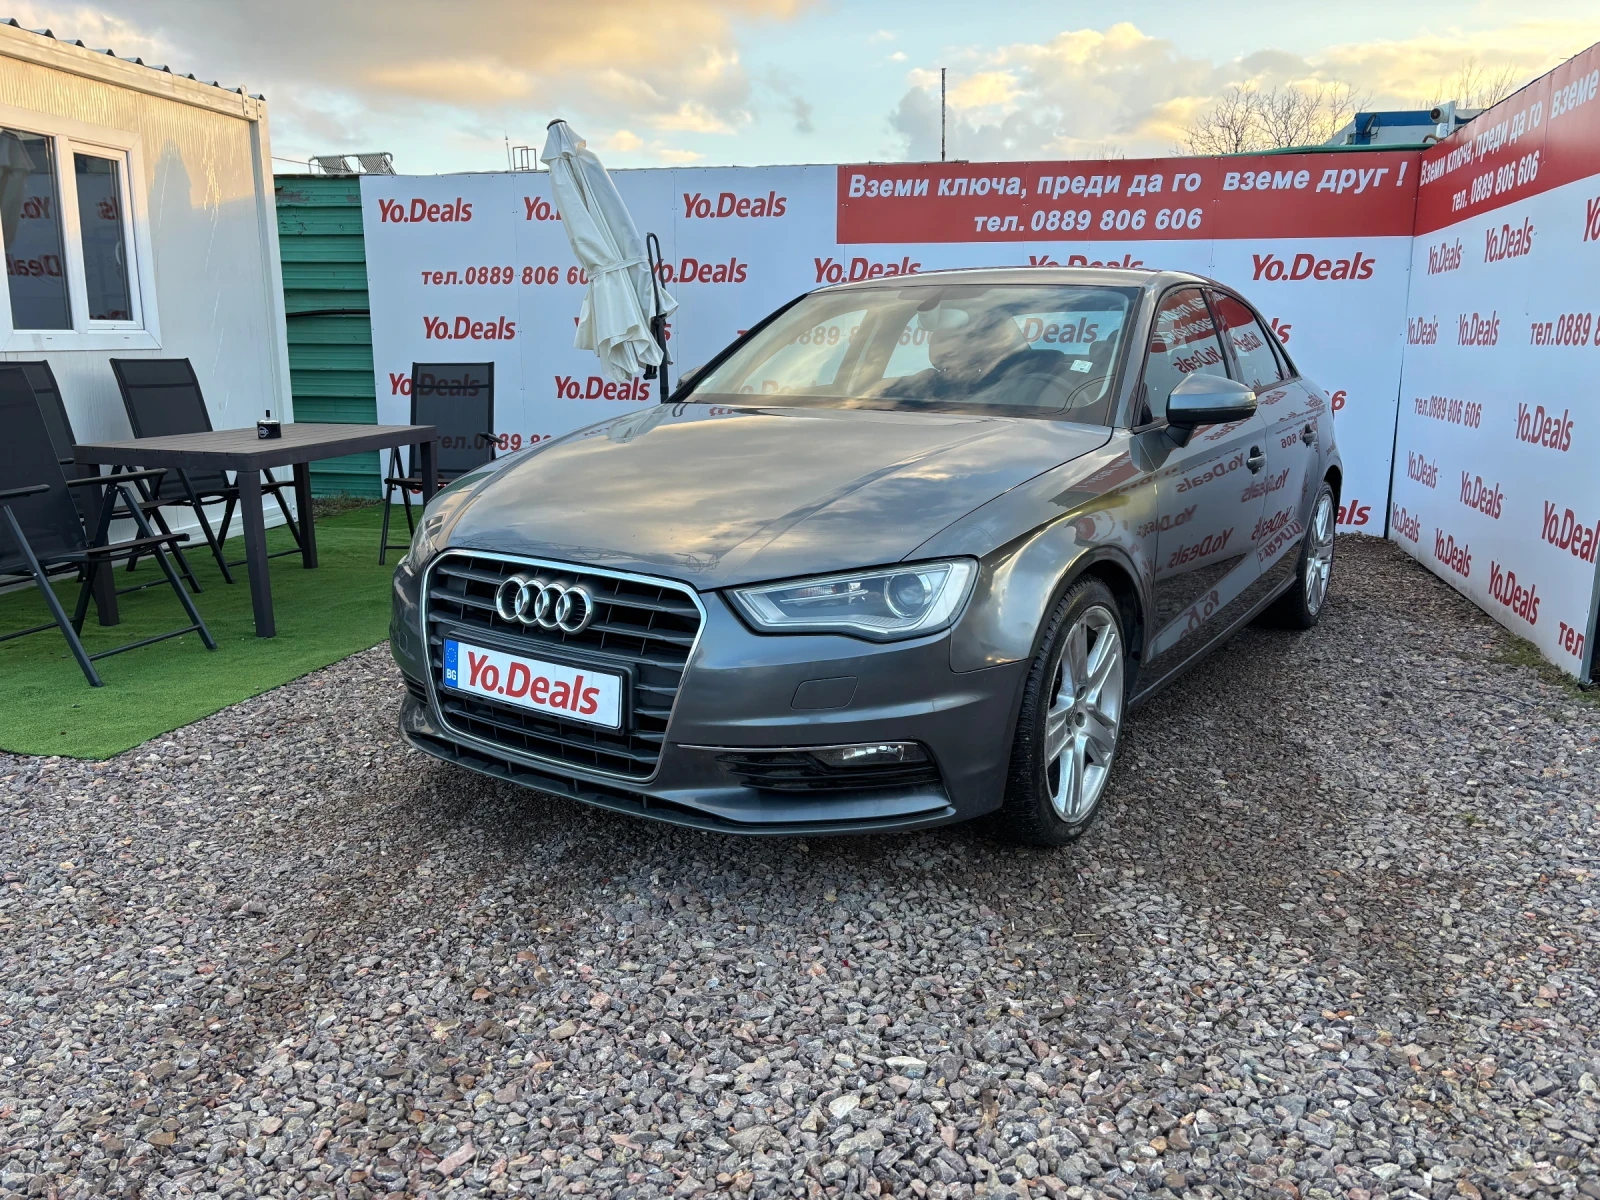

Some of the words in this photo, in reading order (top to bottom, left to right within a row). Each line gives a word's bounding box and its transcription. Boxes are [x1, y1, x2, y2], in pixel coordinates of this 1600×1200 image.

[1420, 158, 1446, 187] Вземи
[1475, 120, 1508, 162] преди
[1508, 109, 1525, 147] да
[1528, 101, 1543, 131] го
[1551, 68, 1599, 120] вземе
[848, 174, 930, 198] Вземи
[937, 175, 1028, 201] ключа,
[1035, 173, 1122, 200] преди
[1127, 173, 1164, 198] да
[1171, 171, 1203, 193] го
[1222, 168, 1311, 191] вземе
[1315, 167, 1390, 195] друг
[1470, 170, 1494, 205] 0889
[1495, 160, 1516, 195] 806
[1517, 150, 1539, 187] 606
[378, 197, 473, 223] Yo.Deals
[683, 191, 787, 218] Yo.Deals
[973, 214, 1025, 232] тел.
[1029, 209, 1092, 232] 0889
[1099, 208, 1147, 231] 806
[1153, 207, 1203, 230] 606
[1427, 237, 1463, 275] Yo.Deals
[1483, 217, 1533, 263] Yo.Deals
[421, 266, 515, 285] тел.0889
[521, 266, 560, 285] 806
[1252, 251, 1376, 281] Yo.Deals
[423, 316, 516, 340] Yo.Deals
[1407, 315, 1438, 345] Yo.Deals
[1457, 310, 1500, 346] Yo.Deals
[1530, 312, 1592, 346] тел.0889
[389, 373, 480, 397] YoDeals
[554, 376, 651, 401] Yo.Deals
[1464, 401, 1482, 429] 606
[1516, 402, 1574, 452] Yo.Deals
[1406, 450, 1438, 489] Yo.Deals
[1460, 470, 1504, 520] Yo.Deals
[1391, 502, 1421, 543] Yo.Deals
[1541, 500, 1600, 564] Yo.Deal
[1433, 528, 1472, 578] Yo.Deals
[1488, 561, 1540, 625] Yo.Deals
[446, 668, 457, 681] BG
[467, 651, 600, 715] Yo.Deals
